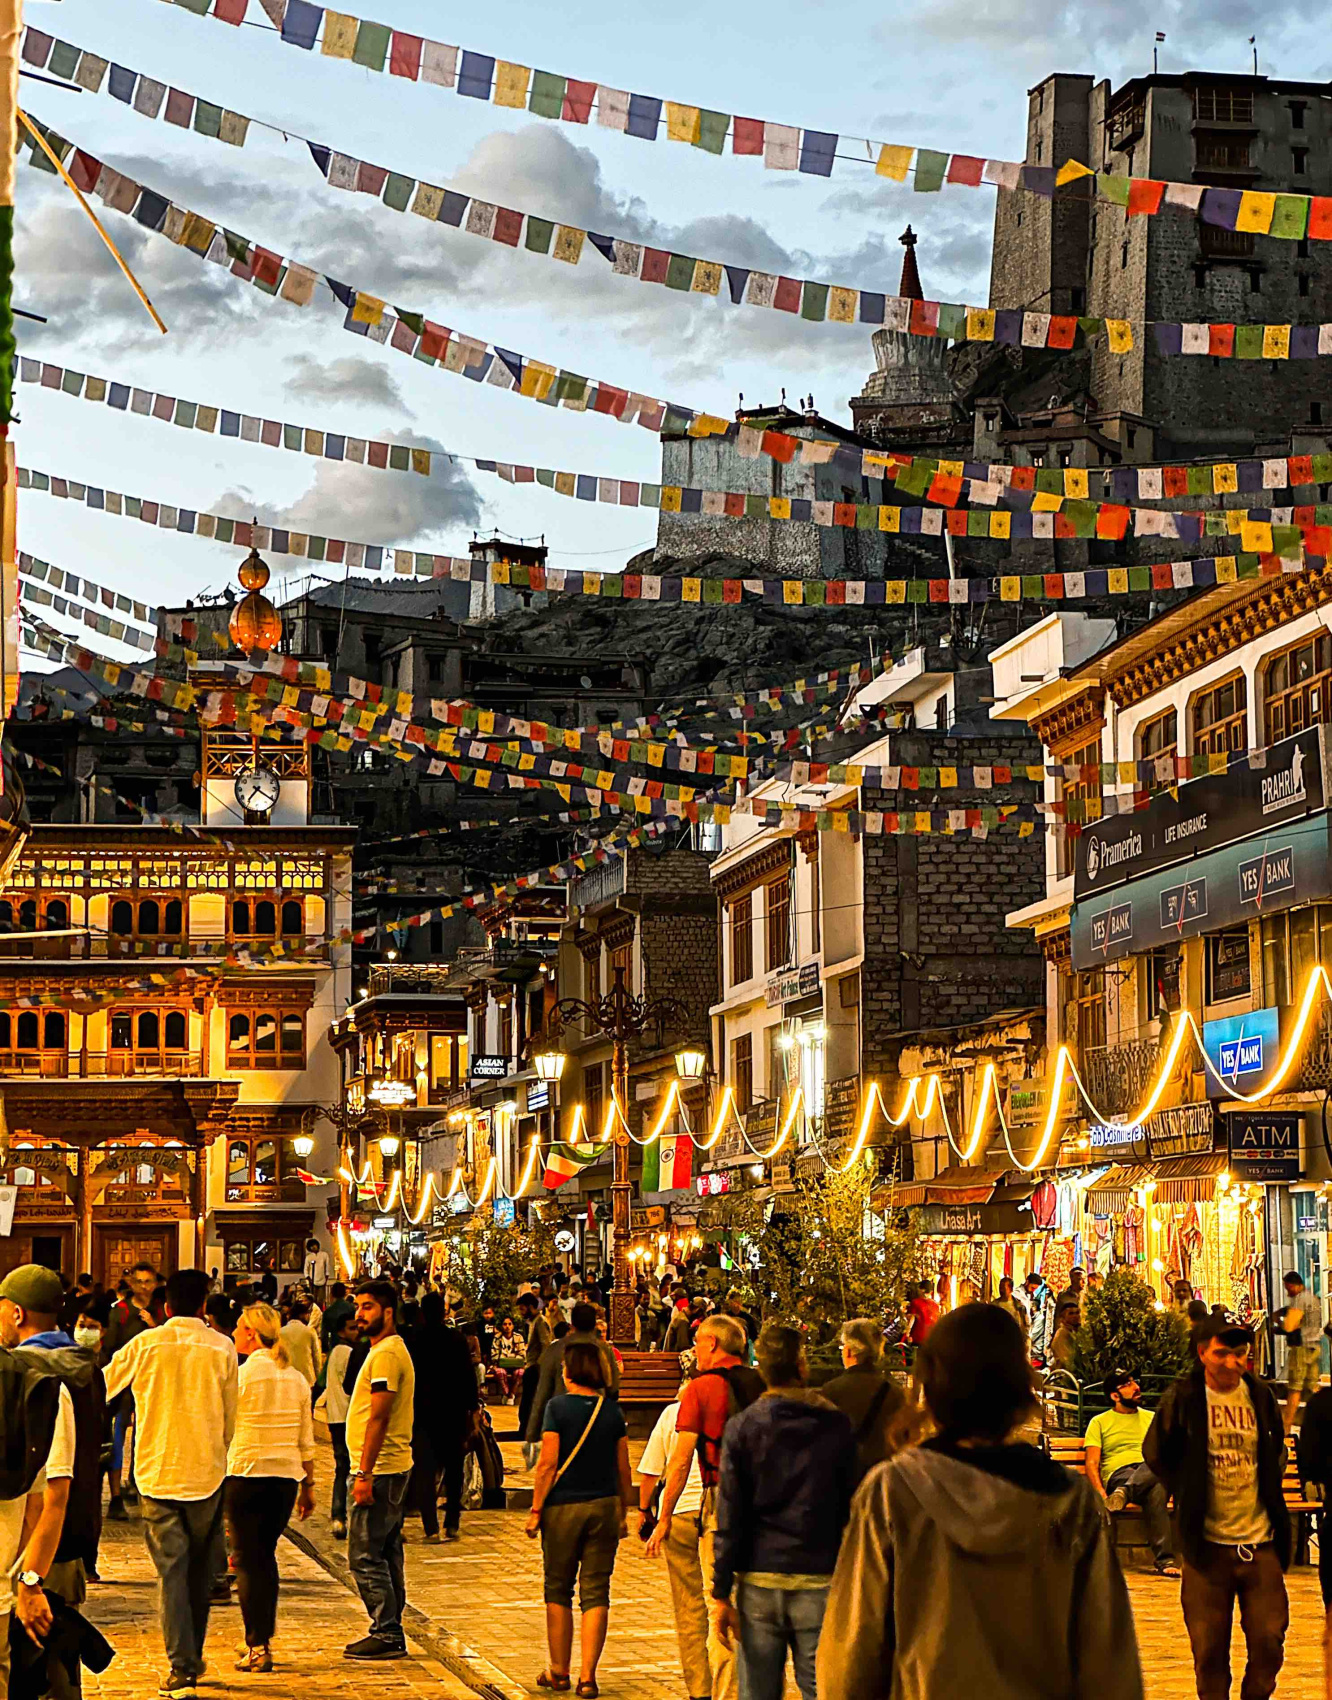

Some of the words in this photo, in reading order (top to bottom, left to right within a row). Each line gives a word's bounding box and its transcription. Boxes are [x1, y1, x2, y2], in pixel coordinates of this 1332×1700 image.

[1262, 768, 1293, 805] PRAHRI
[1165, 826, 1177, 844] LIFE
[1177, 813, 1207, 839] INSURANCE
[1100, 829, 1142, 868] Pramerica
[1242, 867, 1258, 892] YES
[1266, 857, 1291, 885] BANK
[1093, 920, 1105, 940] YES
[1111, 911, 1130, 935] BANK
[473, 1067, 505, 1075] CORNER
[476, 1058, 504, 1067] ASIAN
[1222, 1049, 1235, 1069] YES
[1240, 1044, 1260, 1066] BANK
[1149, 1112, 1170, 1139] ASIAN
[1170, 1106, 1210, 1137] EMPORIUM
[1241, 1126, 1291, 1146] ATM
[940, 1211, 966, 1230] Lhasa
[966, 1206, 982, 1231] Art
